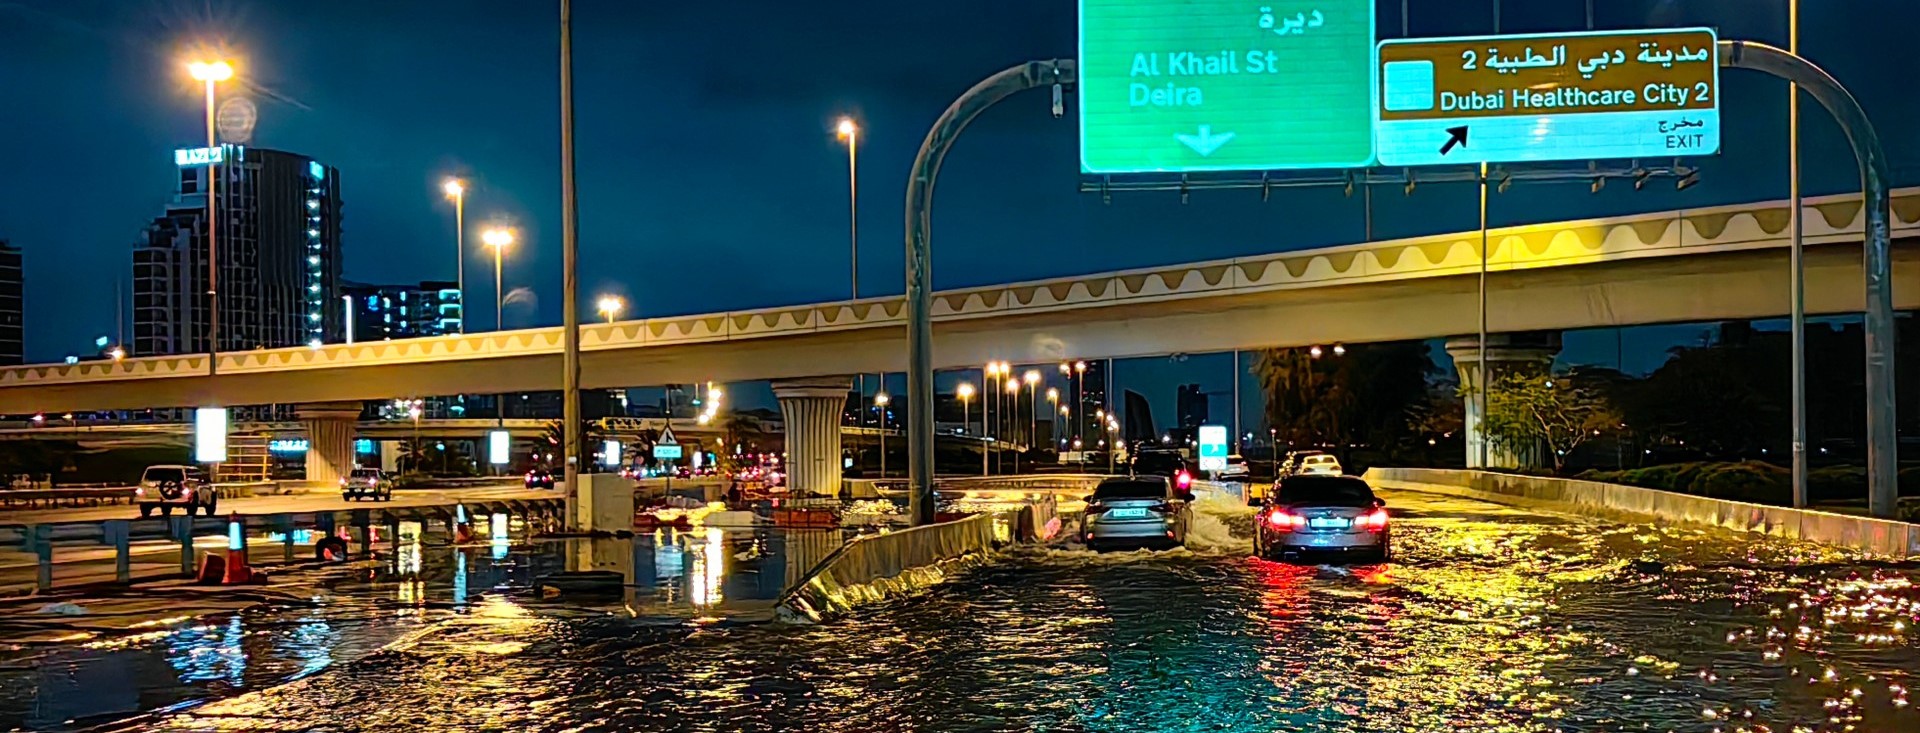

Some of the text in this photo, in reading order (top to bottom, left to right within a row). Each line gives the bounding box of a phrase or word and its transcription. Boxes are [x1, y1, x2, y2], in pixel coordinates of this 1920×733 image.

[1258, 6, 1324, 35] ديرة
[1130, 49, 1279, 77] Al Khail St
[1461, 42, 1709, 79] مدينة دبي الطبية 2
[1129, 82, 1203, 107] Deira
[1440, 82, 1709, 111] Dubai Healthcare City 2
[1657, 117, 1704, 133] مخرج
[1666, 134, 1703, 149] EXIT
